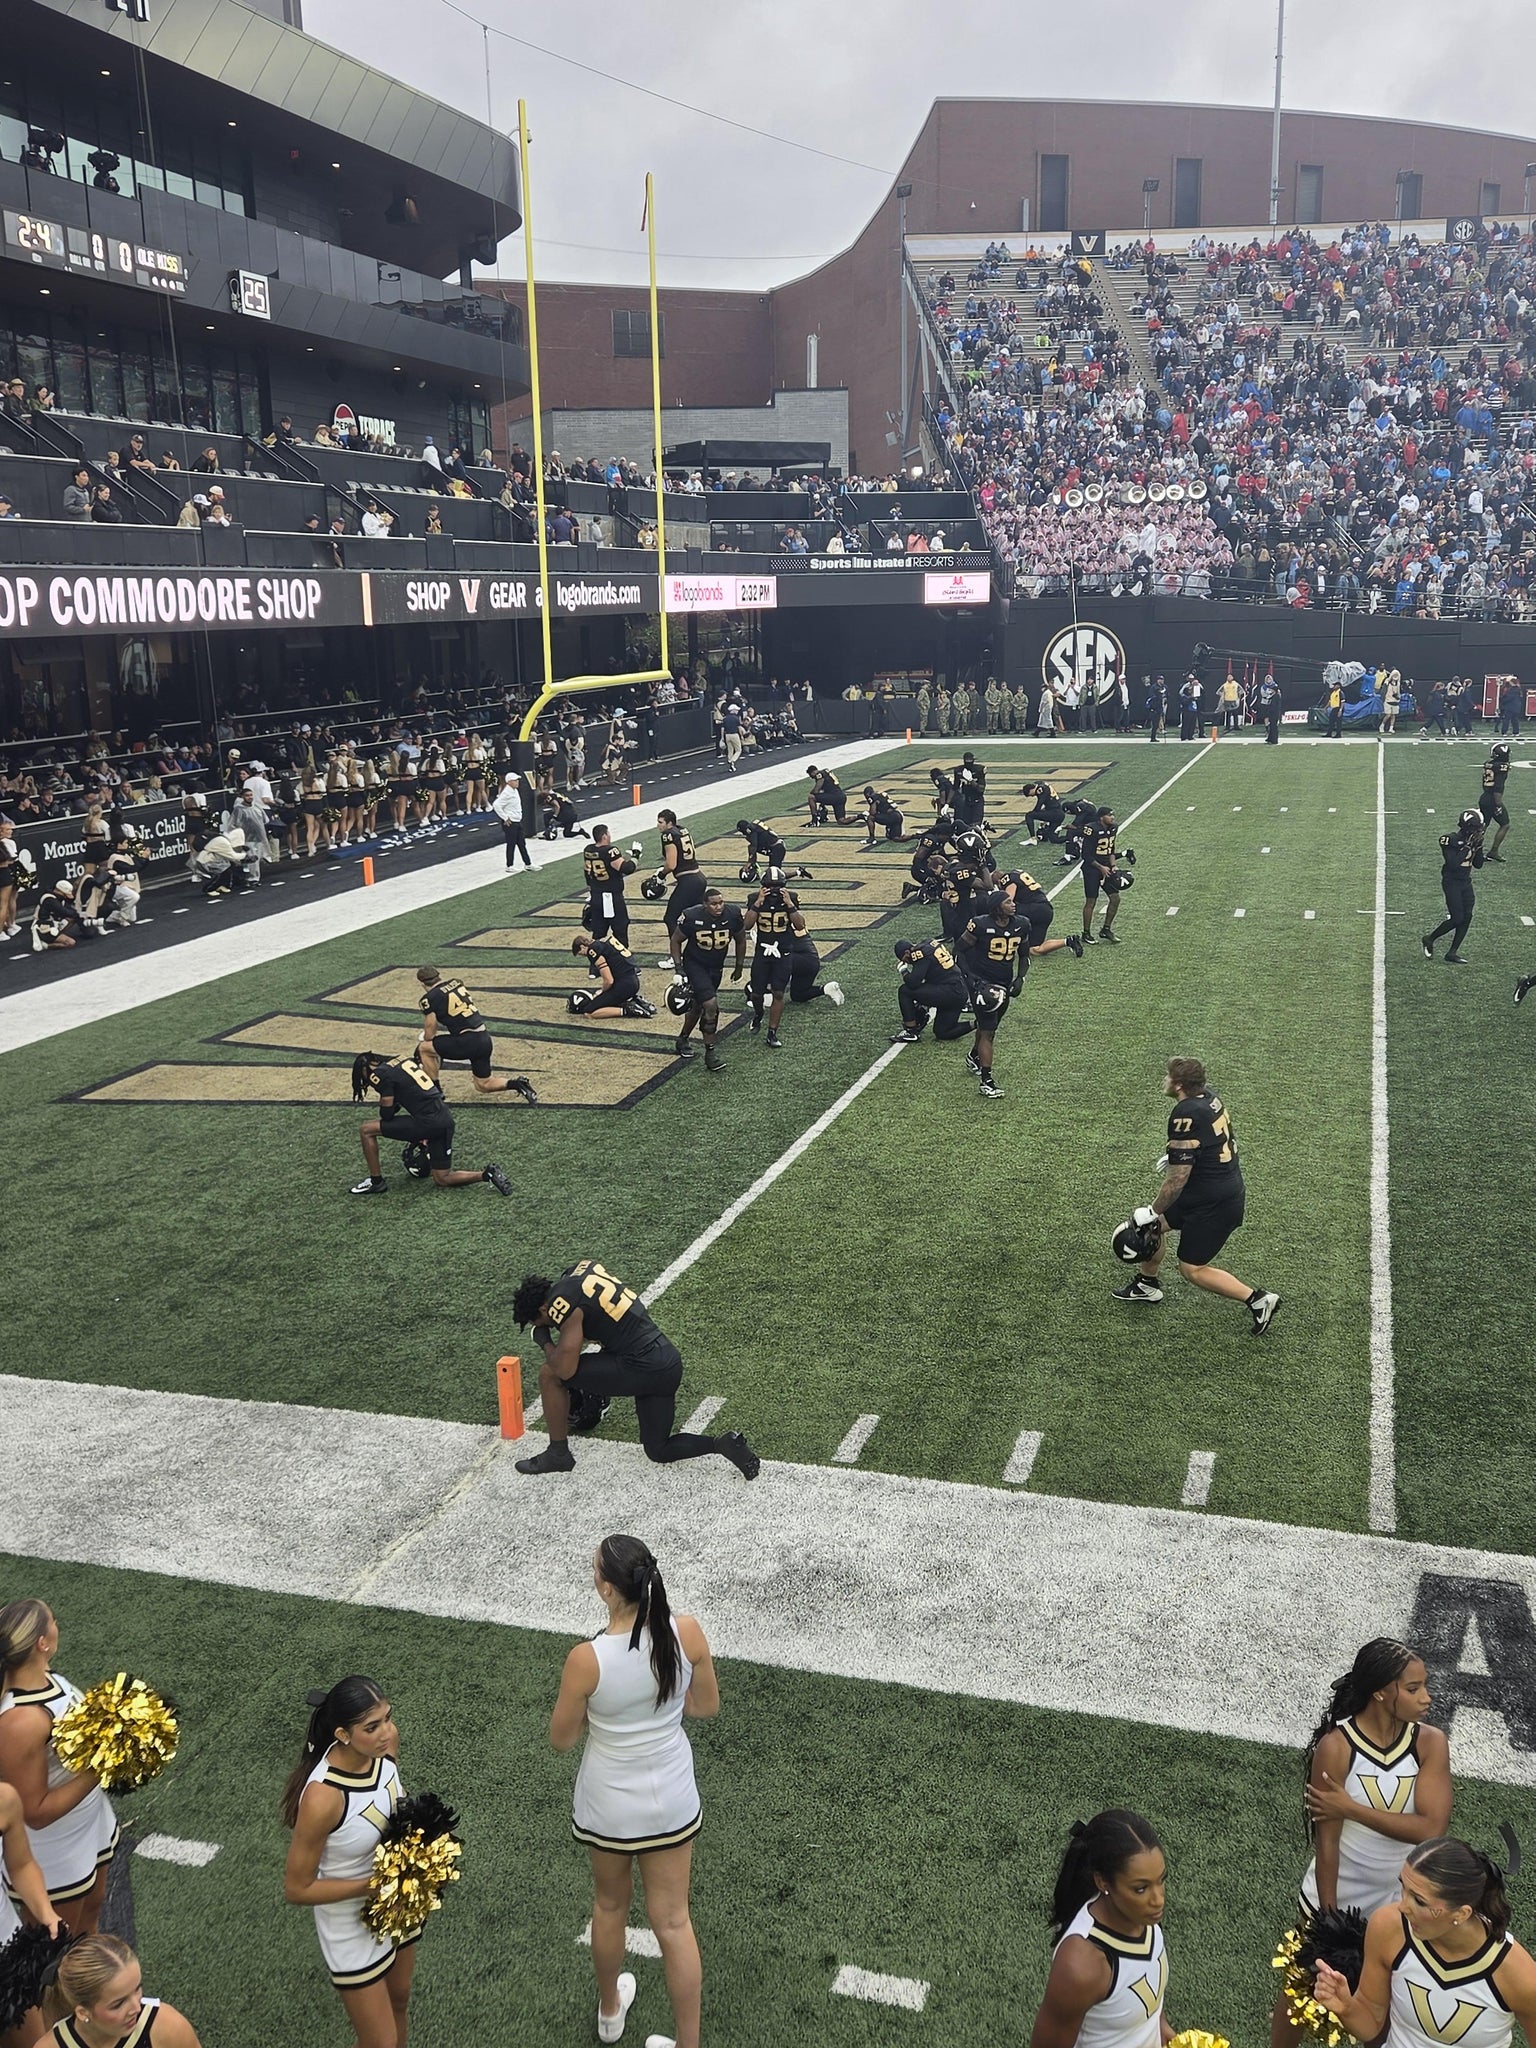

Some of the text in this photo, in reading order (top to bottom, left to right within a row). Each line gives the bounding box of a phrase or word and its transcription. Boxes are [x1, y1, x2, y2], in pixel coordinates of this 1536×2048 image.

[1455, 221, 1473, 240] SEC
[1078, 235, 1099, 252] V
[118, 242, 133, 273] 0
[244, 279, 266, 312] 25
[810, 557, 852, 570] Sports
[913, 555, 955, 568] RESORTS
[49, 576, 254, 626] COMMODORE
[257, 577, 322, 619] SHOP
[406, 581, 451, 611] SHOP
[489, 582, 527, 609] GEAR
[556, 580, 642, 612] logobrands.com
[682, 580, 770, 609] logobrands 2:32 PM
[1049, 629, 1118, 698] SEC
[43, 840, 88, 861] Monro
[155, 815, 186, 838] Child
[64, 861, 85, 880] Ho
[956, 868, 970, 880] 26
[1020, 871, 1042, 892] 9
[757, 911, 789, 933] 50
[695, 929, 730, 951] 58
[911, 949, 924, 961] 99
[370, 1072, 381, 1085] 6
[401, 1060, 435, 1091] 6
[1173, 1117, 1193, 1133] 77
[1212, 1108, 1238, 1163] 7
[548, 1296, 571, 1325] 29
[1404, 1977, 1488, 2046] V
